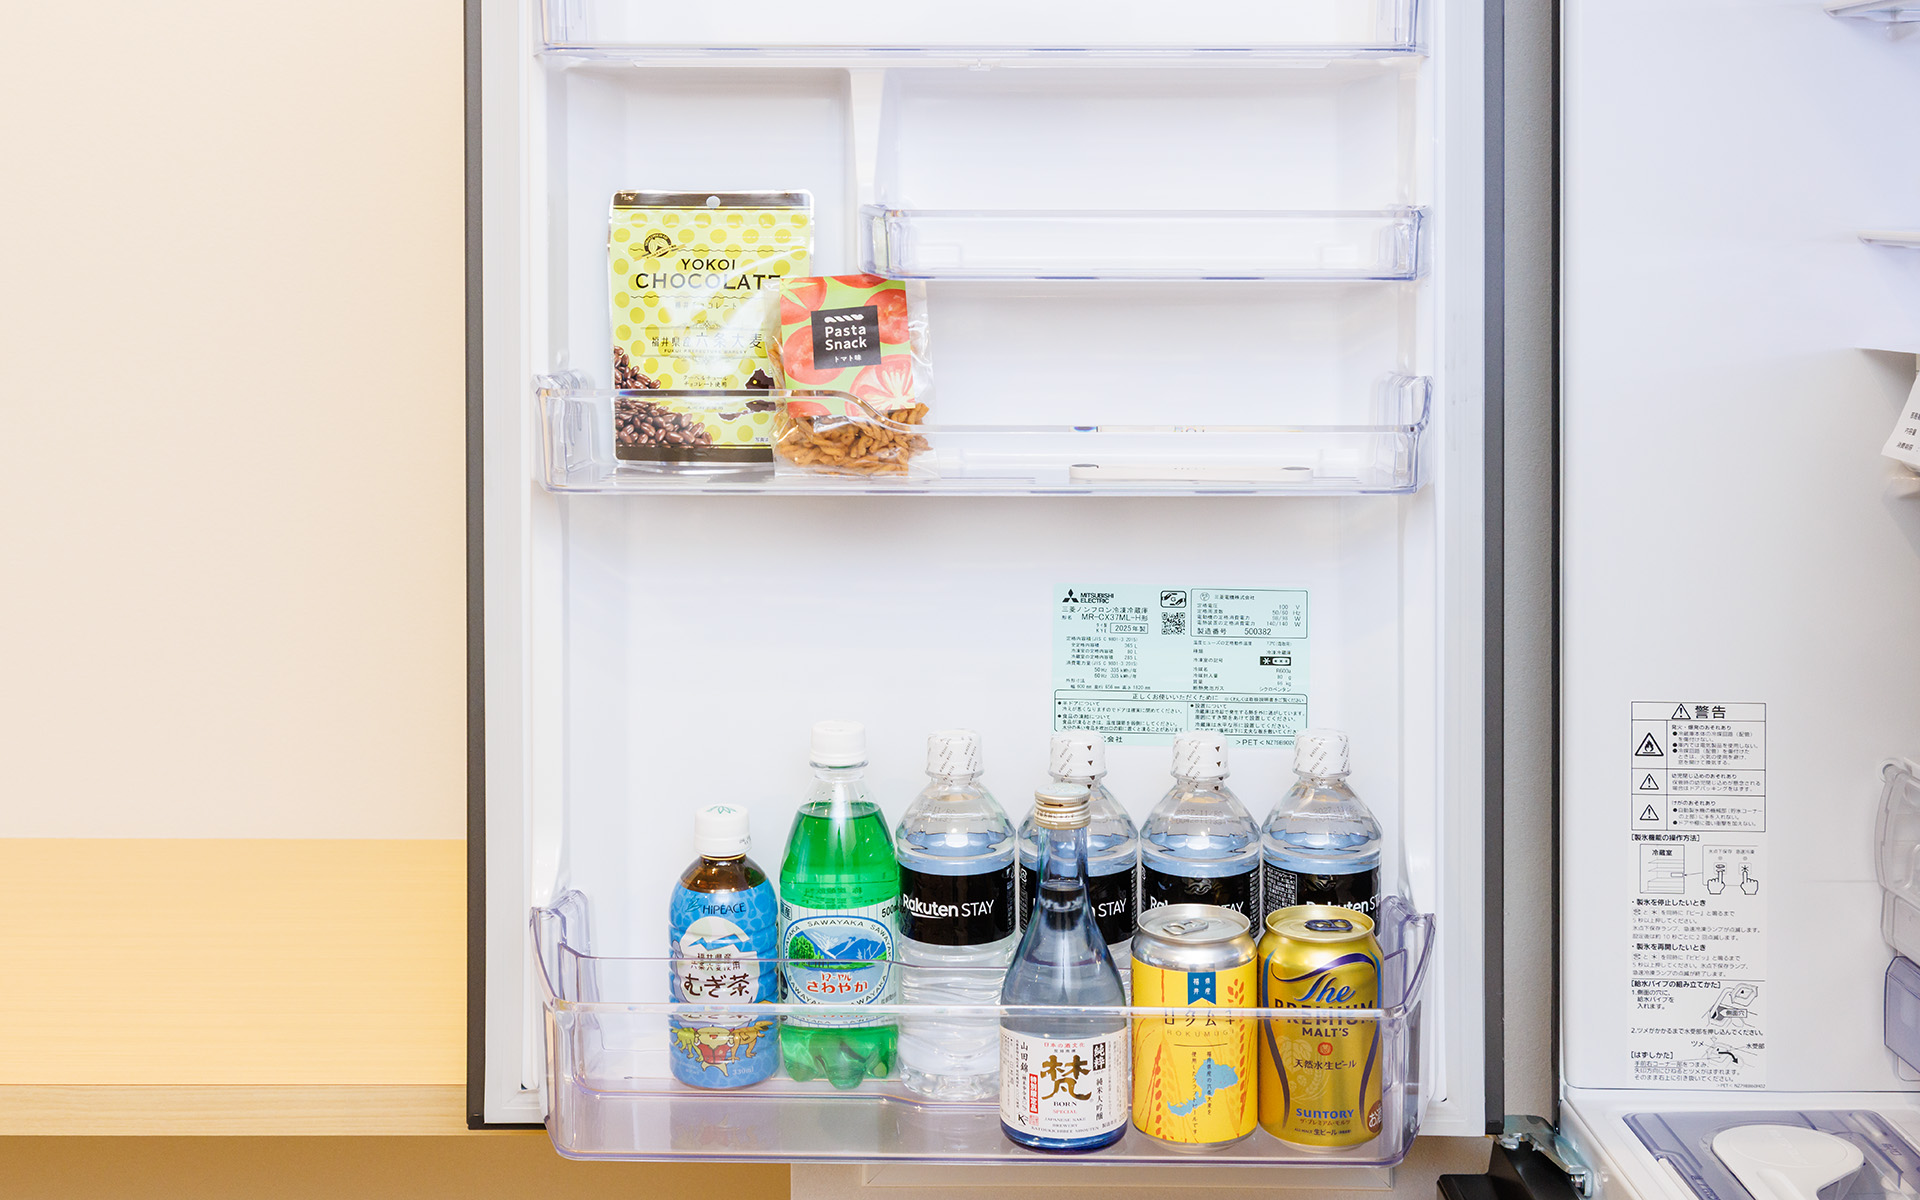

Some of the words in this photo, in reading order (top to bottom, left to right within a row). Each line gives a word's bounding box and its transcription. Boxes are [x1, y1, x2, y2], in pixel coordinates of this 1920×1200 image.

[681, 258, 736, 271] YOKOI
[824, 324, 867, 338] Pasta
[825, 336, 868, 351] Snack
[834, 354, 862, 364] トマト味
[1114, 624, 1146, 633] 2025年製
[1695, 705, 1726, 719] 警告
[1651, 848, 1673, 857] 冷蔵室
[903, 893, 959, 918] Rakuten
[961, 899, 994, 918] STAY
[1098, 897, 1127, 917] STAY
[807, 919, 864, 927] SAWAYAKA
[1636, 943, 1706, 951] 製氷を再開したいとき
[684, 973, 750, 998] むぎ茶
[807, 980, 869, 994] さわやか
[1294, 972, 1356, 1003] The
[1167, 1029, 1235, 1038] ROKUMUGI
[1302, 1027, 1349, 1037] MALT'S
[1690, 1040, 1704, 1048] ツメ
[1020, 1041, 1029, 1073] 山田錦
[1294, 1058, 1357, 1070] 天然水生ビール
[732, 1066, 754, 1075] 330ml
[1040, 1054, 1092, 1101] 梵
[1095, 1077, 1104, 1121] 純米大吟醸
[1296, 1108, 1354, 1119] SUNTORY
[1313, 1128, 1338, 1136] 生ビール
